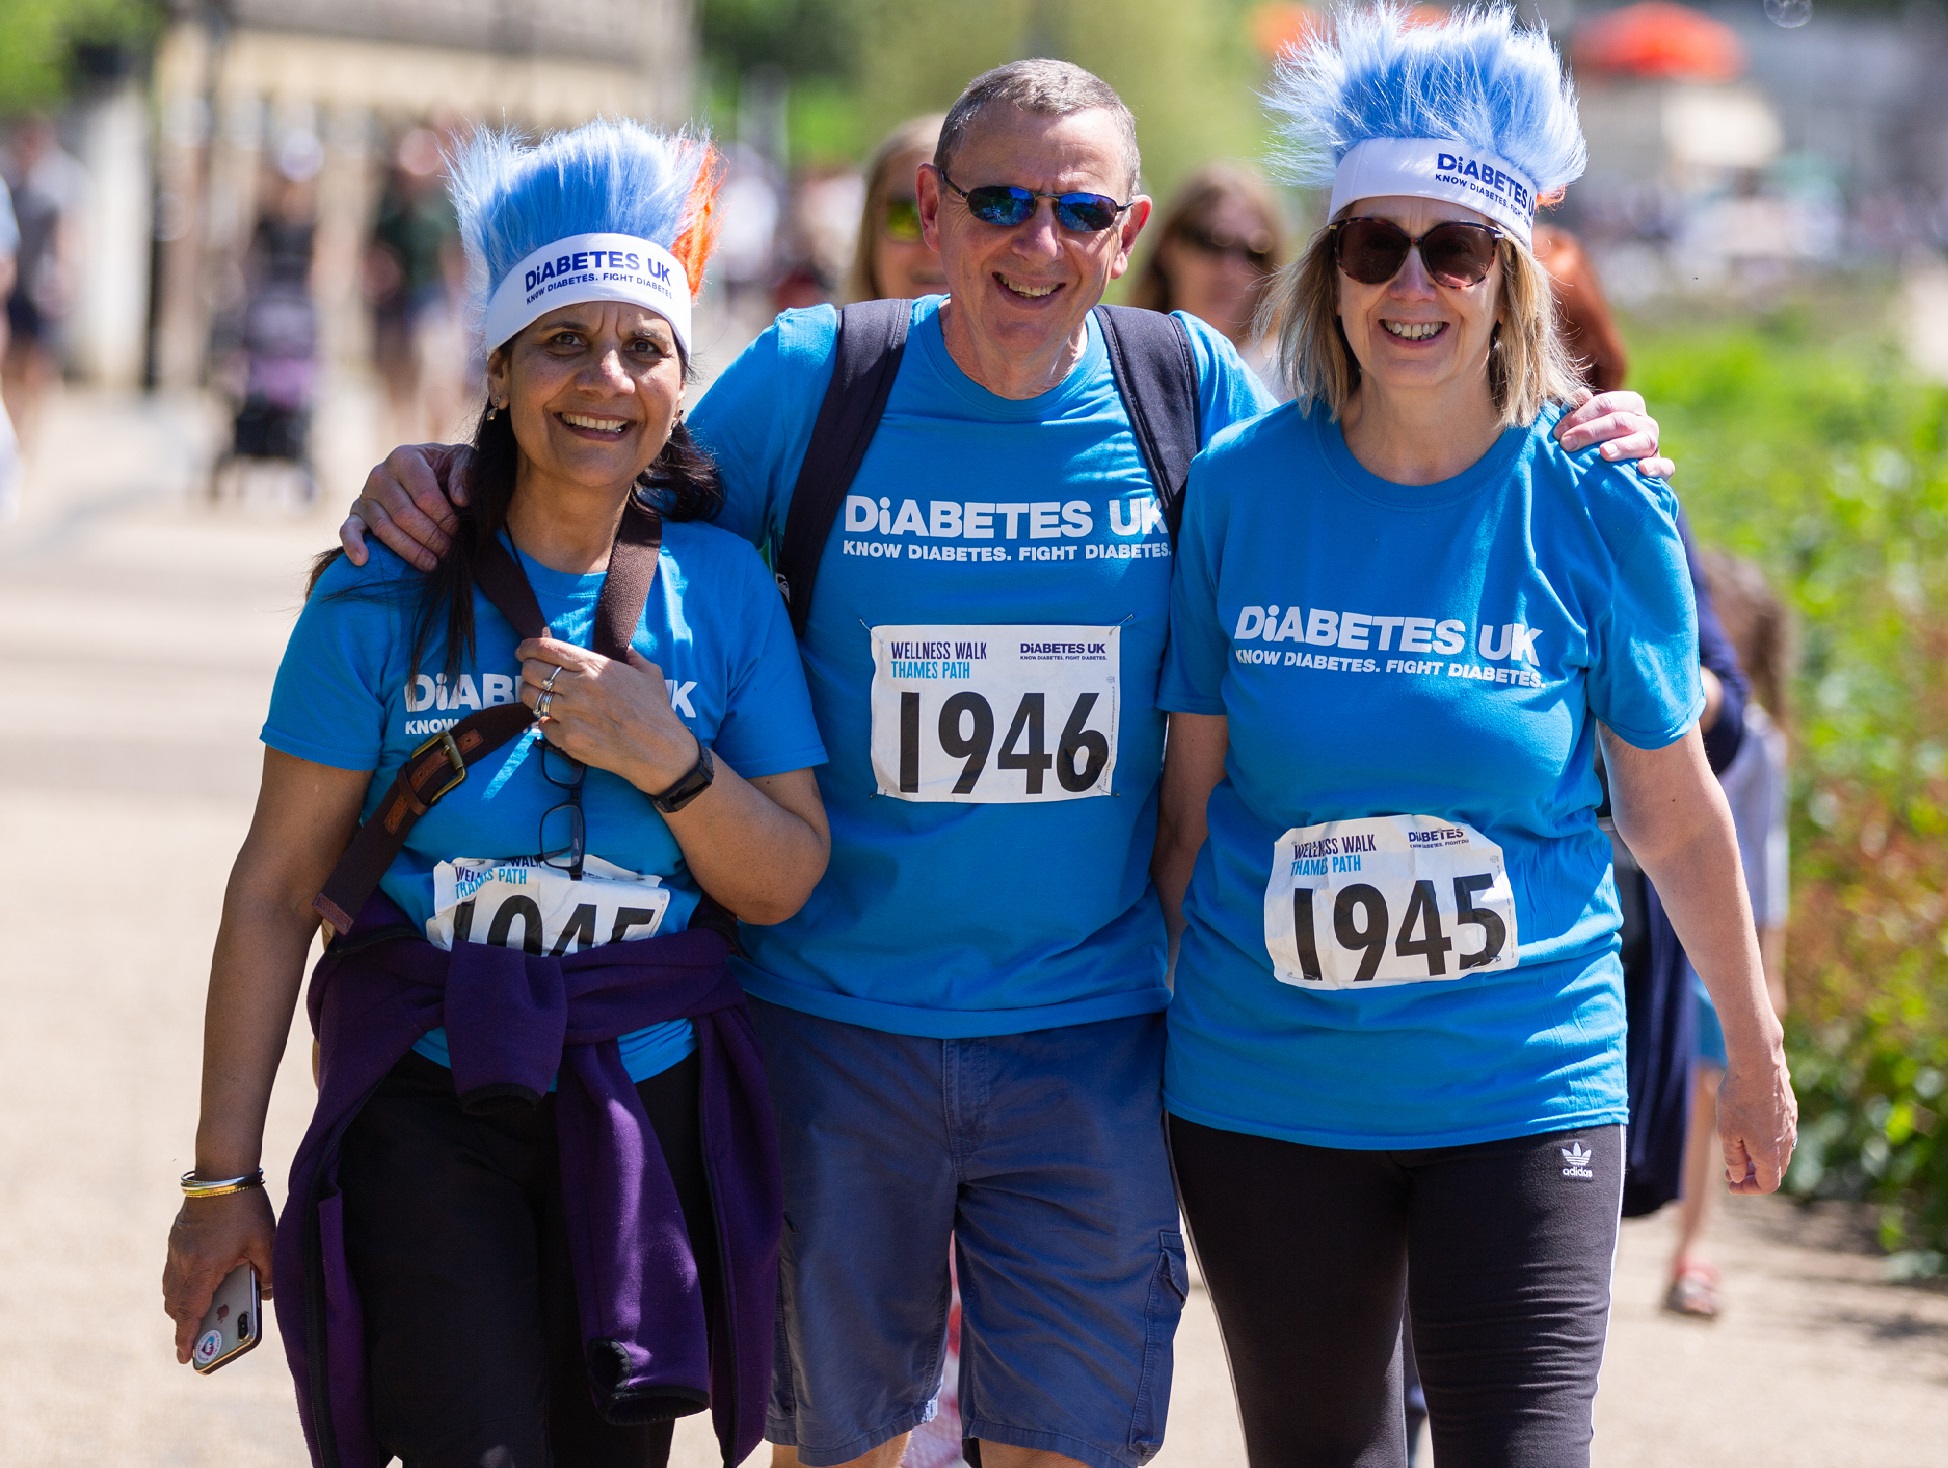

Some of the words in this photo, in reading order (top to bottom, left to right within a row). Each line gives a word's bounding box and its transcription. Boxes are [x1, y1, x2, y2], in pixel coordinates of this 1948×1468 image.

[1435, 173, 1467, 187] KNOW
[648, 258, 671, 287] UK
[526, 287, 545, 305] KNOW
[547, 273, 598, 292] DIABETES.
[603, 272, 634, 283] FIGHT
[1109, 498, 1168, 536] UK
[843, 540, 902, 558] KNOW
[908, 545, 1012, 562] DIABETES.
[1019, 546, 1077, 561] FIGHT
[1086, 542, 1172, 559] DIABETES.
[891, 641, 951, 660] WELLNESS
[955, 641, 987, 660] WALK
[1087, 643, 1106, 654] UK
[1478, 623, 1544, 667] UK
[891, 661, 938, 679] THAMES
[942, 661, 970, 679] PATH
[1235, 649, 1281, 666] KNOW
[1284, 652, 1380, 673] DIABETES.
[1386, 660, 1443, 675] FIGHT
[1448, 663, 1546, 688] DIABETES.
[404, 673, 522, 712] DiAB
[405, 718, 460, 735] KNOW
[900, 691, 1109, 794] 1946
[1341, 834, 1376, 853] WALK
[1332, 855, 1361, 873] PATH
[498, 868, 527, 884] PATH
[1294, 873, 1506, 981] 1945
[1562, 1166, 1593, 1178] adidas
